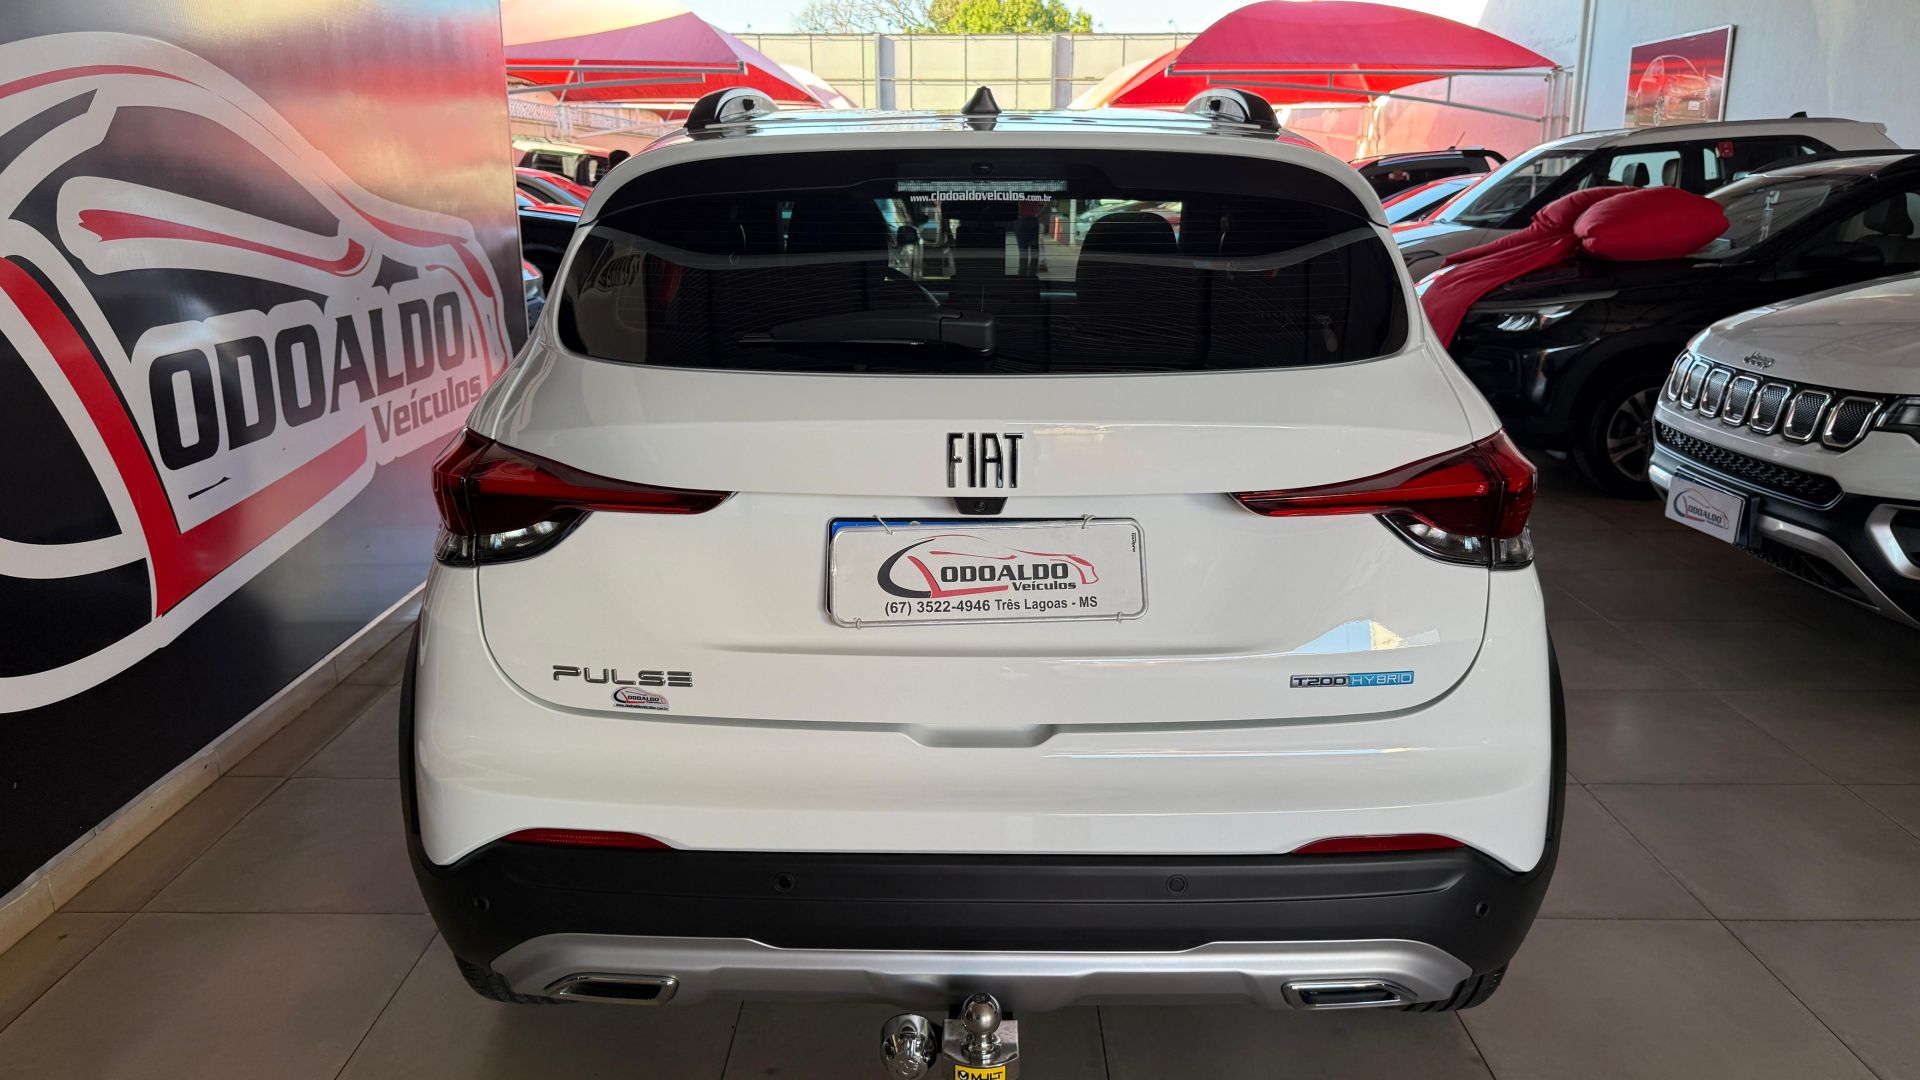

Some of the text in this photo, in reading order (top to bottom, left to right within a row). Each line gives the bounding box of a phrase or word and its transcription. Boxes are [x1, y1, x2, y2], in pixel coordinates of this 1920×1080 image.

[371, 375, 482, 444] Veículos
[947, 432, 1024, 488] FIAT
[1012, 581, 1077, 591] Veículos
[885, 601, 912, 616] (67)
[916, 600, 991, 613] 3522-4946
[995, 599, 1021, 610] Três
[1024, 598, 1068, 612] Lagoas
[1079, 596, 1098, 608] MS
[552, 664, 693, 687] PULSE
